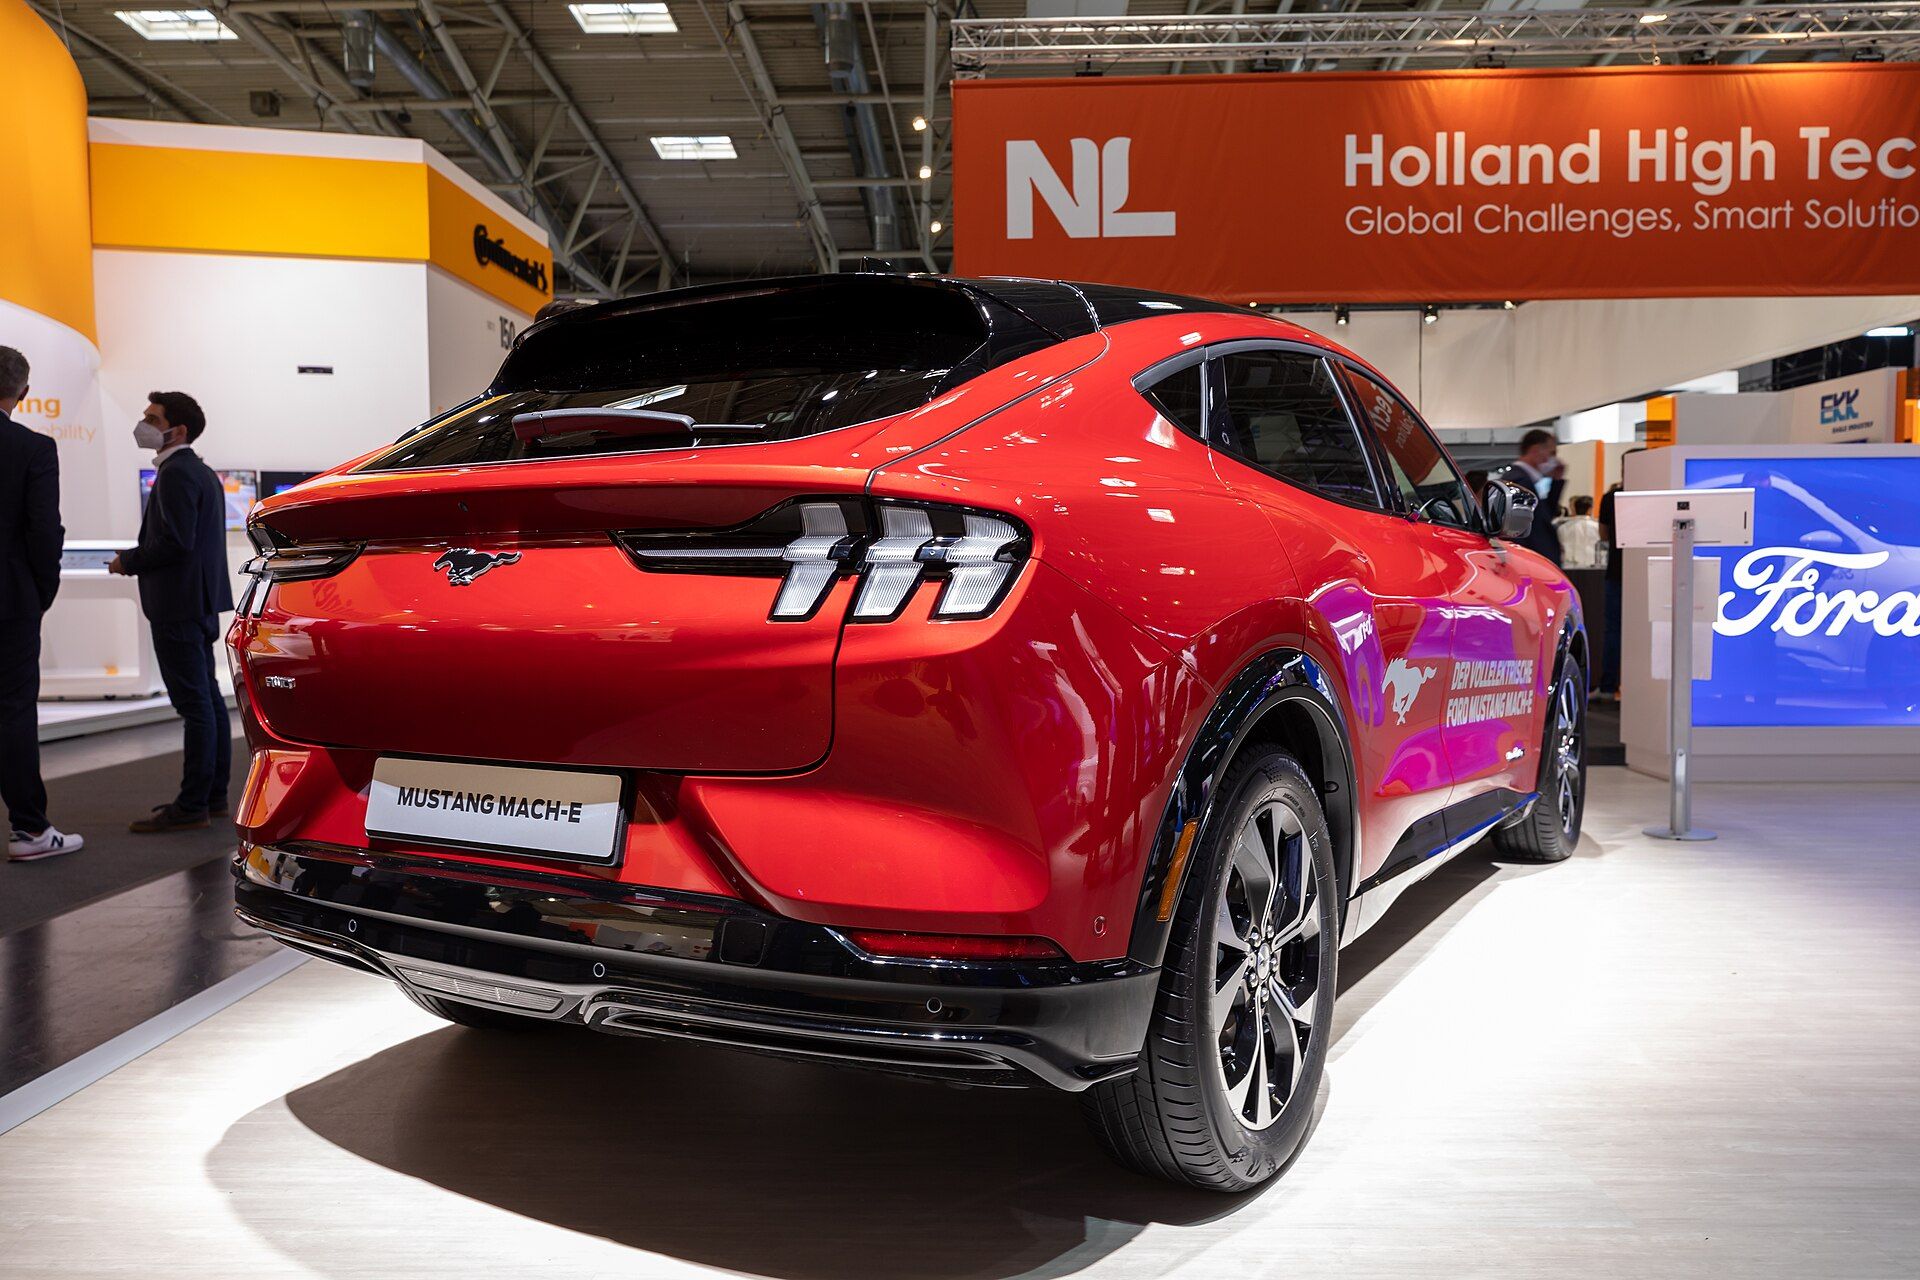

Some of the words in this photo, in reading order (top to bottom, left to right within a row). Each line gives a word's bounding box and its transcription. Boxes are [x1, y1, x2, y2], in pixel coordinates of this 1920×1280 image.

[1345, 128, 1600, 187] Holland
[1628, 126, 1776, 196] High
[1799, 126, 1918, 180] Tec
[1006, 137, 1176, 239] NL
[1345, 203, 1462, 235] Global
[1474, 202, 1682, 239] Challenges,
[1693, 200, 1794, 230] Smart
[1804, 197, 1919, 229] Solutio
[1821, 389, 1859, 424] EKK
[37, 424, 97, 443] obility
[1451, 661, 1471, 690] DER
[1469, 660, 1534, 688] VOLLELEKTRISCHE
[1446, 697, 1469, 728] FORD
[1469, 692, 1506, 723] MUSTANG
[1505, 690, 1534, 717] MACH-E
[397, 786, 495, 814] MUSTANG
[497, 795, 583, 824] MACH-E
[50, 835, 64, 848] N
